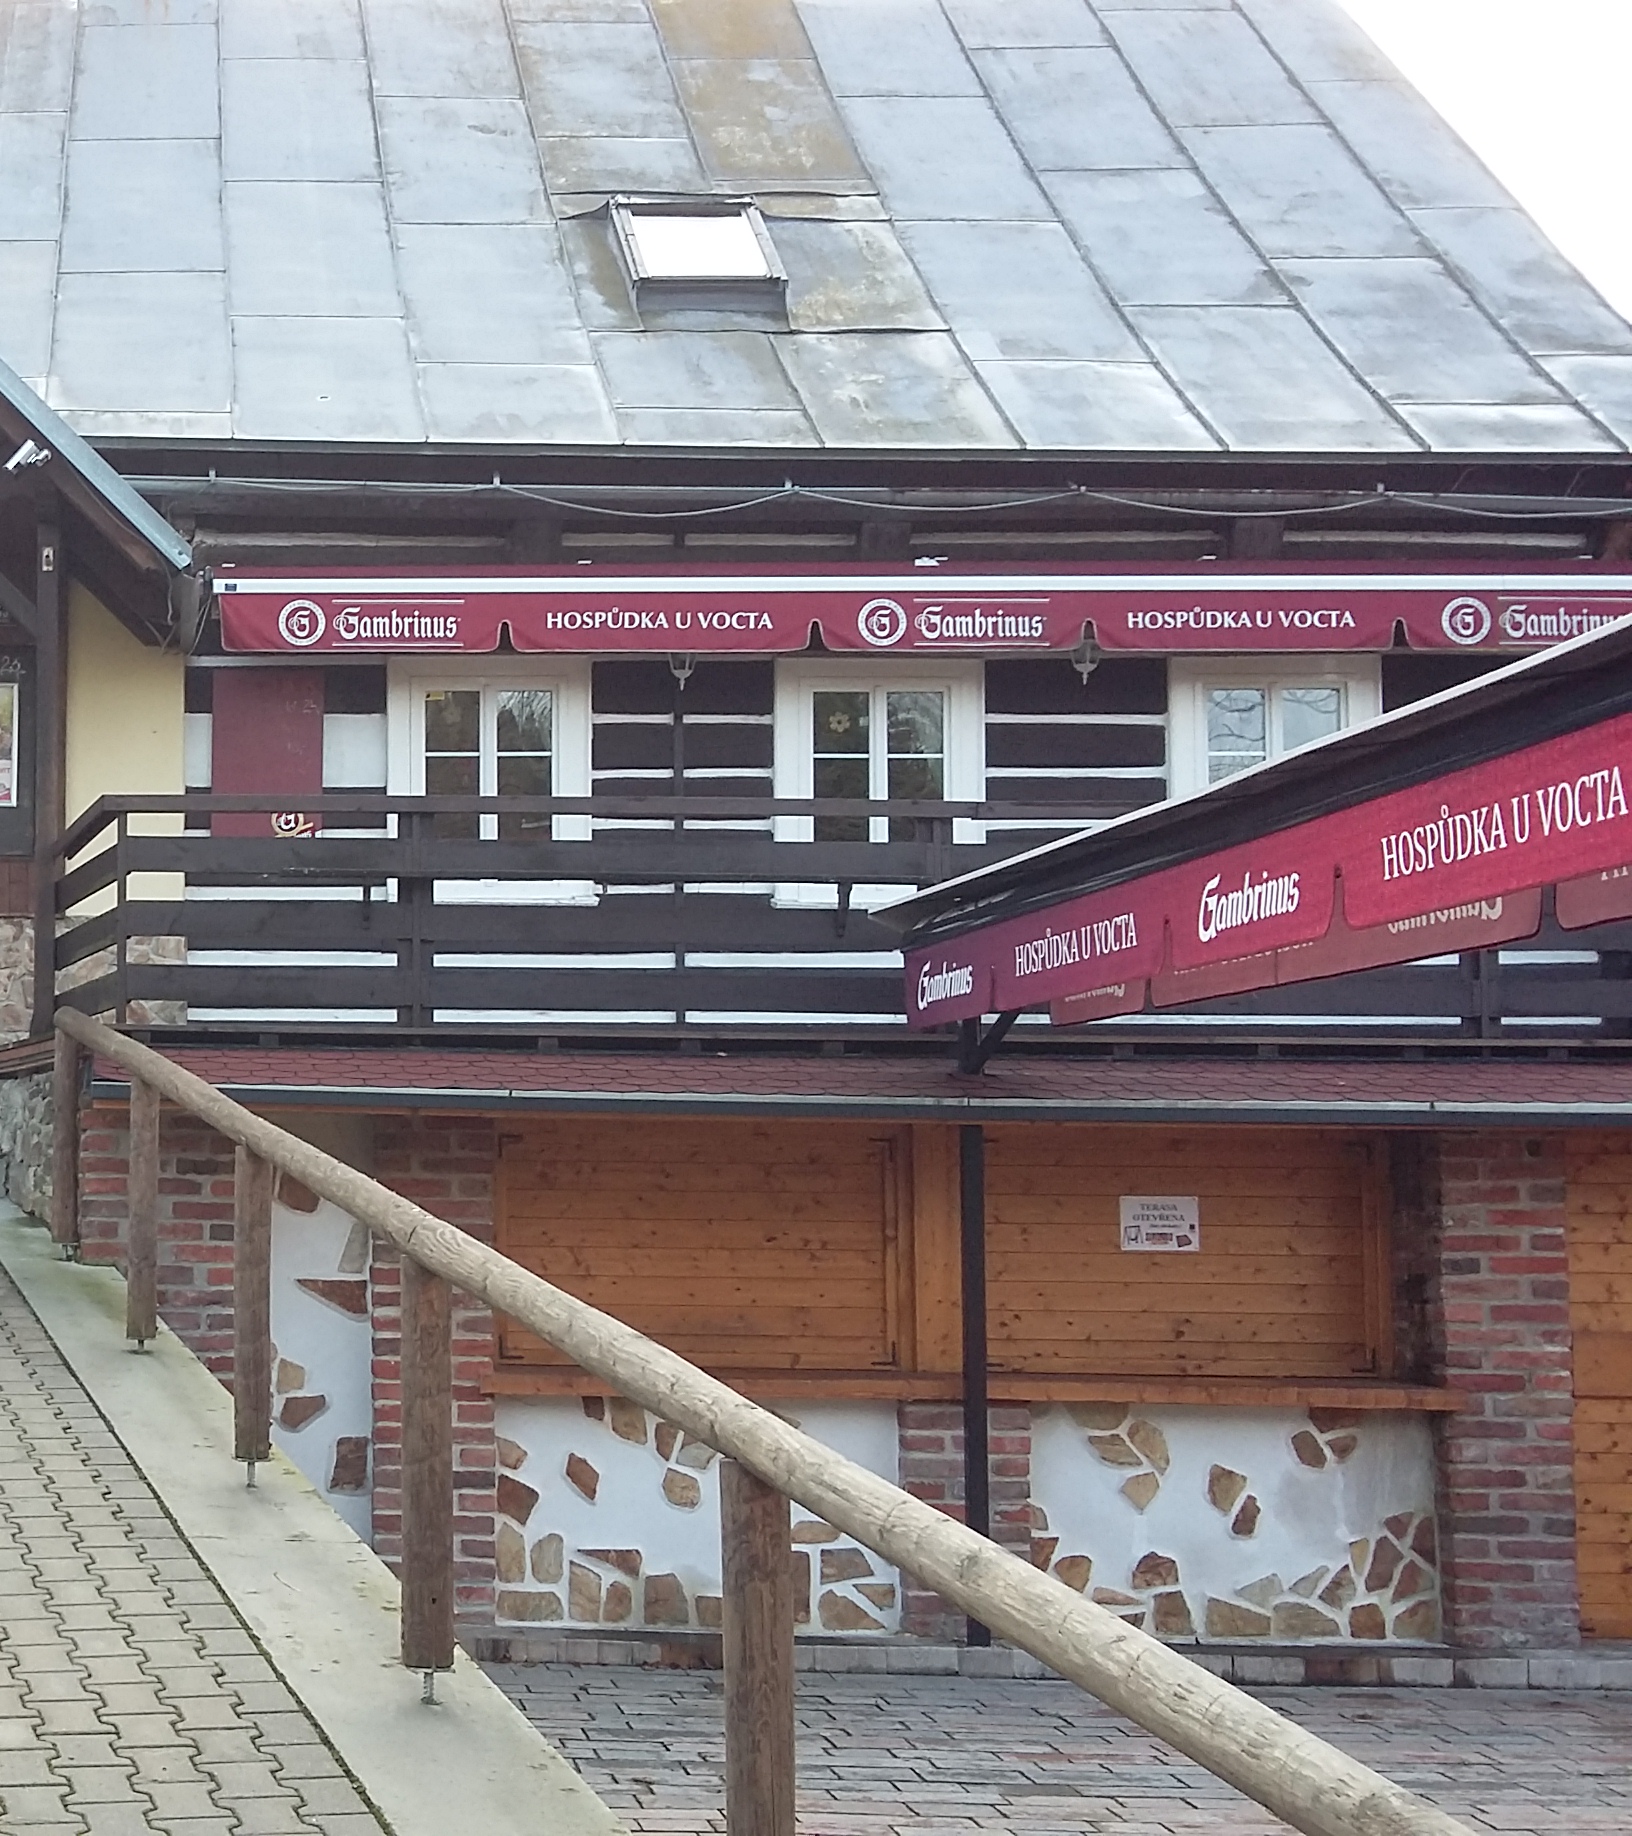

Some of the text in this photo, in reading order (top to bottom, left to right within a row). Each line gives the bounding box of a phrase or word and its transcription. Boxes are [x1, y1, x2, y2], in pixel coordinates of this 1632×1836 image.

[333, 606, 461, 640] Gambrinus
[546, 606, 774, 630] HOSPŮDKA U VOCTA
[914, 605, 1047, 640] Gambrinus
[1127, 605, 1356, 629] HOSPŮDKA U VOCTA
[1381, 766, 1629, 881] HOSPŮDKA U VOCTA
[1197, 871, 1300, 943] Gambrinus
[1014, 912, 1138, 978] HOSPŮDKA U VOCTA
[917, 960, 974, 1010] Gambrinus
[1132, 1212, 1185, 1222] OTEVŘENA
[1139, 1203, 1178, 1212] TERASA
